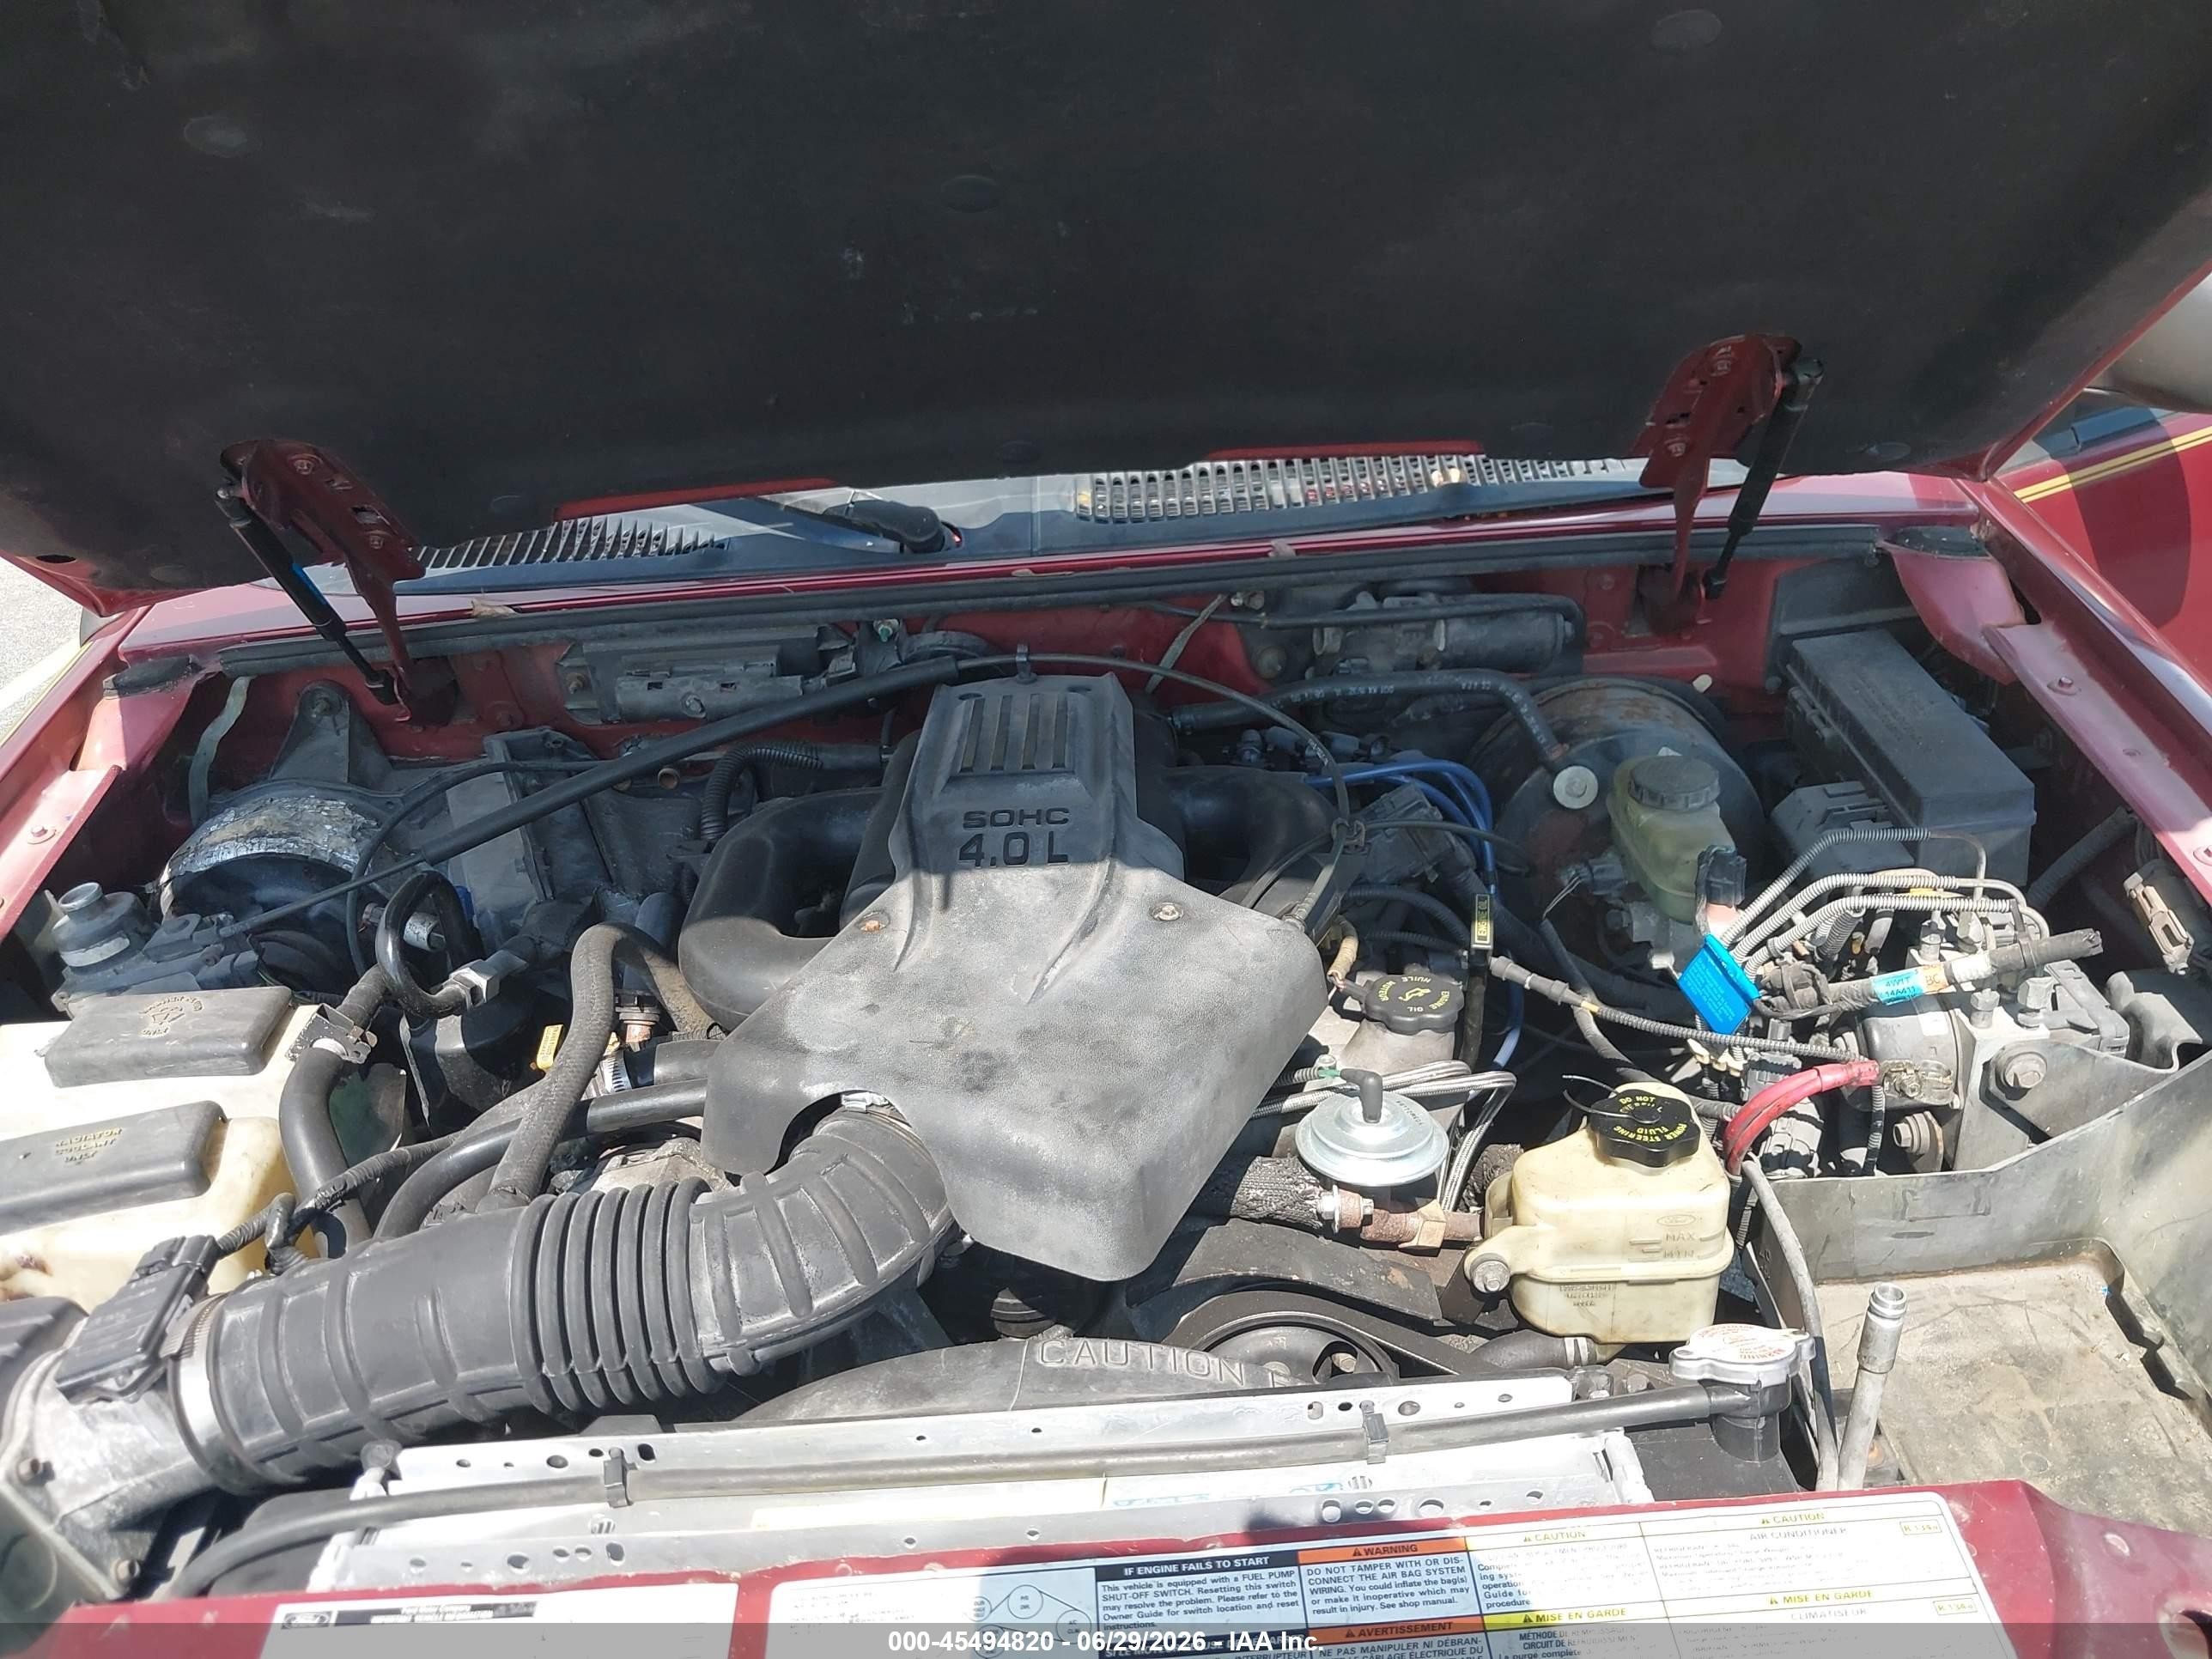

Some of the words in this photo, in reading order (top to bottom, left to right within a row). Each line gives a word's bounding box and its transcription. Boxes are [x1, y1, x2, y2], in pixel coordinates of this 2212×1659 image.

[963, 807, 1070, 829] SOHC
[959, 832, 1030, 867] 4.0
[1047, 830, 1070, 864] L
[1378, 981, 1396, 1002] MOTEUR
[1429, 991, 1450, 1010] ENGINE
[1613, 1126, 1661, 1142] STEERING
[1637, 1126, 1668, 1135] FLUID
[1664, 1123, 1687, 1140] POWER
[1666, 1232, 1694, 1242] MAX
[1038, 1340, 1245, 1386] CAUTION
[1773, 1512, 1825, 1524] CAUTION
[1534, 1531, 1586, 1541] CAUTION
[1364, 1544, 1418, 1556] WARNING
[1124, 1567, 1134, 1577] IF
[1138, 1564, 1179, 1575] ENGINE
[1182, 1560, 1212, 1571] FAILS
[1217, 1559, 1231, 1569] TO
[1234, 1556, 1270, 1567] START
[1307, 1568, 1322, 1577] DO
[1350, 1563, 1391, 1573] TAMPER
[1395, 1560, 1421, 1569] WITH
[1425, 1558, 1439, 1566] OR
[1443, 1556, 1464, 1565] DIS-
[1102, 1584, 1120, 1593] This
[1123, 1581, 1153, 1591] vehicle
[1157, 1579, 1164, 1588] is
[1168, 1577, 1207, 1589] equipped
[1211, 1575, 1230, 1584] with
[1242, 1572, 1266, 1582] FUEL
[1268, 1570, 1295, 1579] PUMP
[1308, 1575, 1354, 1586] CONNECT
[1358, 1573, 1379, 1582] THE
[1401, 1569, 1422, 1578] BAG
[1425, 1566, 1466, 1577] SYSTEM
[1310, 1585, 1346, 1595] WIRING.
[1349, 1583, 1366, 1592] You
[1368, 1581, 1393, 1590] could
[1395, 1579, 1422, 1589] inflate
[1425, 1577, 1438, 1586] the
[1441, 1574, 1468, 1586] bag(s)
[1480, 1573, 1495, 1583] ing
[1102, 1591, 1149, 1602] SHUT-OFF
[1153, 1588, 1193, 1598] SWITCH.
[1198, 1585, 1241, 1596] Resetting
[1266, 1580, 1297, 1589] switch
[1324, 1595, 1349, 1604] make
[1363, 1590, 1415, 1602] inoperative
[1418, 1587, 1446, 1596] which
[1450, 1586, 1470, 1595] may
[1484, 1590, 1514, 1600] Guide
[1784, 1595, 1810, 1604] MISE
[1815, 1592, 1830, 1601] EN
[1834, 1590, 1873, 1601] GARDE
[1103, 1604, 1121, 1613] may
[1124, 1601, 1156, 1610] resolve
[1158, 1599, 1172, 1607] the
[1176, 1595, 1214, 1607] problem.
[1218, 1594, 1245, 1603] Please
[1248, 1591, 1268, 1601] refer
[1284, 1589, 1298, 1598] the
[1312, 1606, 1336, 1615] result
[1350, 1602, 1378, 1613] injury.
[1380, 1601, 1396, 1610] See
[1398, 1598, 1420, 1610] shop
[1422, 1597, 1458, 1607] manual.
[1103, 1612, 1133, 1621] Owner
[1137, 1609, 1164, 1620] Guide
[1167, 1607, 1179, 1616] for
[1183, 1605, 1212, 1615] switch
[1216, 1603, 1253, 1613] location
[1256, 1601, 1273, 1611] and
[1277, 1600, 1299, 1608] reset
[1535, 1613, 1565, 1623] MISE
[1568, 1611, 1583, 1620] EN
[1587, 1608, 1626, 1619] GARDE
[1103, 1620, 1158, 1631] instructions.
[1358, 1621, 1454, 1638] AVERTISSEMENT
[1320, 1649, 1333, 1657] NE
[1337, 1647, 1356, 1656] PAS
[1360, 1641, 1419, 1654] MANIPULER
[1423, 1640, 1432, 1649] NI
[1469, 1646, 1484, 1655] DU
[1522, 1639, 1553, 1650] CIRCUIT
[1555, 1639, 1565, 1648] DE
